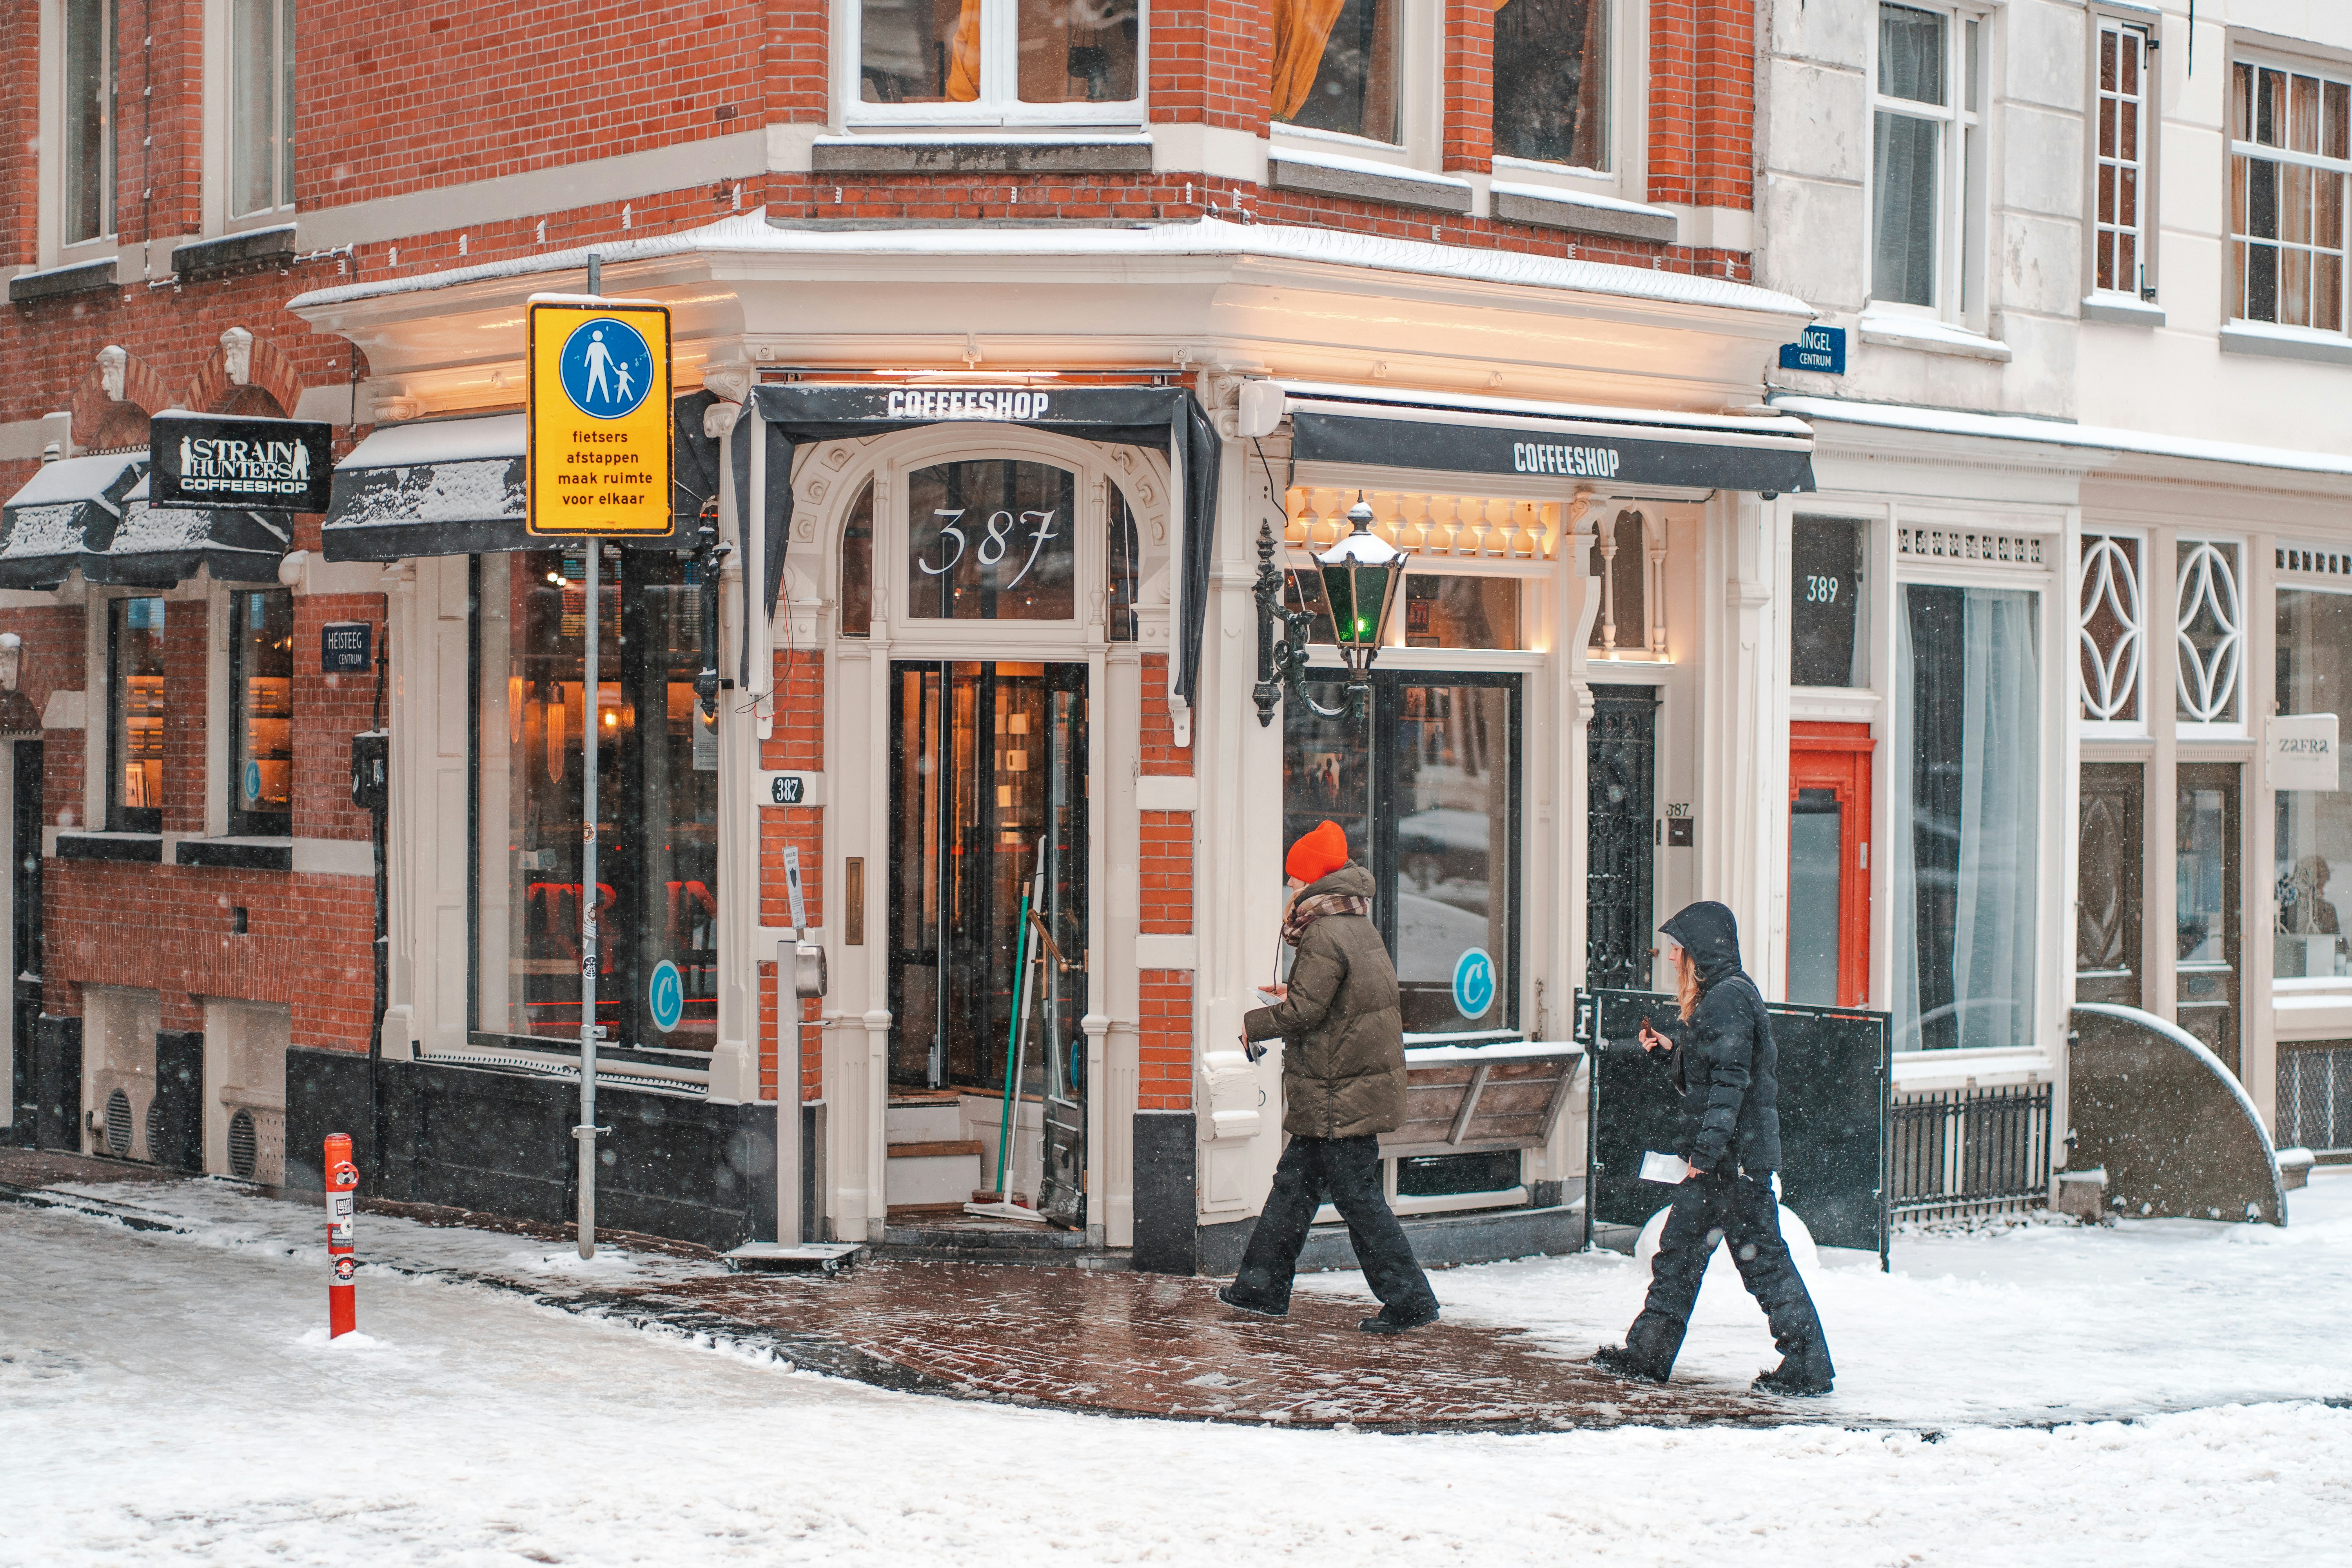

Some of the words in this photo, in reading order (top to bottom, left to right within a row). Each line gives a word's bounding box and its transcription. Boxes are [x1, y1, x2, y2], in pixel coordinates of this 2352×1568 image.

[1797, 331, 1831, 351] INGEL
[1799, 353, 1831, 367] CENTRUM
[888, 391, 1049, 419] COFFEESHOP
[573, 431, 628, 443] fietsers
[192, 438, 293, 463] STRAIN
[566, 452, 639, 465] afstappen
[1514, 442, 1619, 477] COFFEESHOP
[192, 459, 293, 479] HUNTERS
[181, 478, 308, 494] COFFEESHOP
[558, 472, 597, 484] maak
[604, 472, 653, 484] ruimte
[563, 494, 594, 505] voor
[599, 493, 645, 505] elkaar
[918, 508, 1058, 589] 387
[1806, 575, 1838, 603] 389
[328, 632, 361, 649] HEISTEEG
[339, 653, 361, 664] CENTRUM
[777, 779, 799, 801] 387
[1666, 803, 1689, 816] 387
